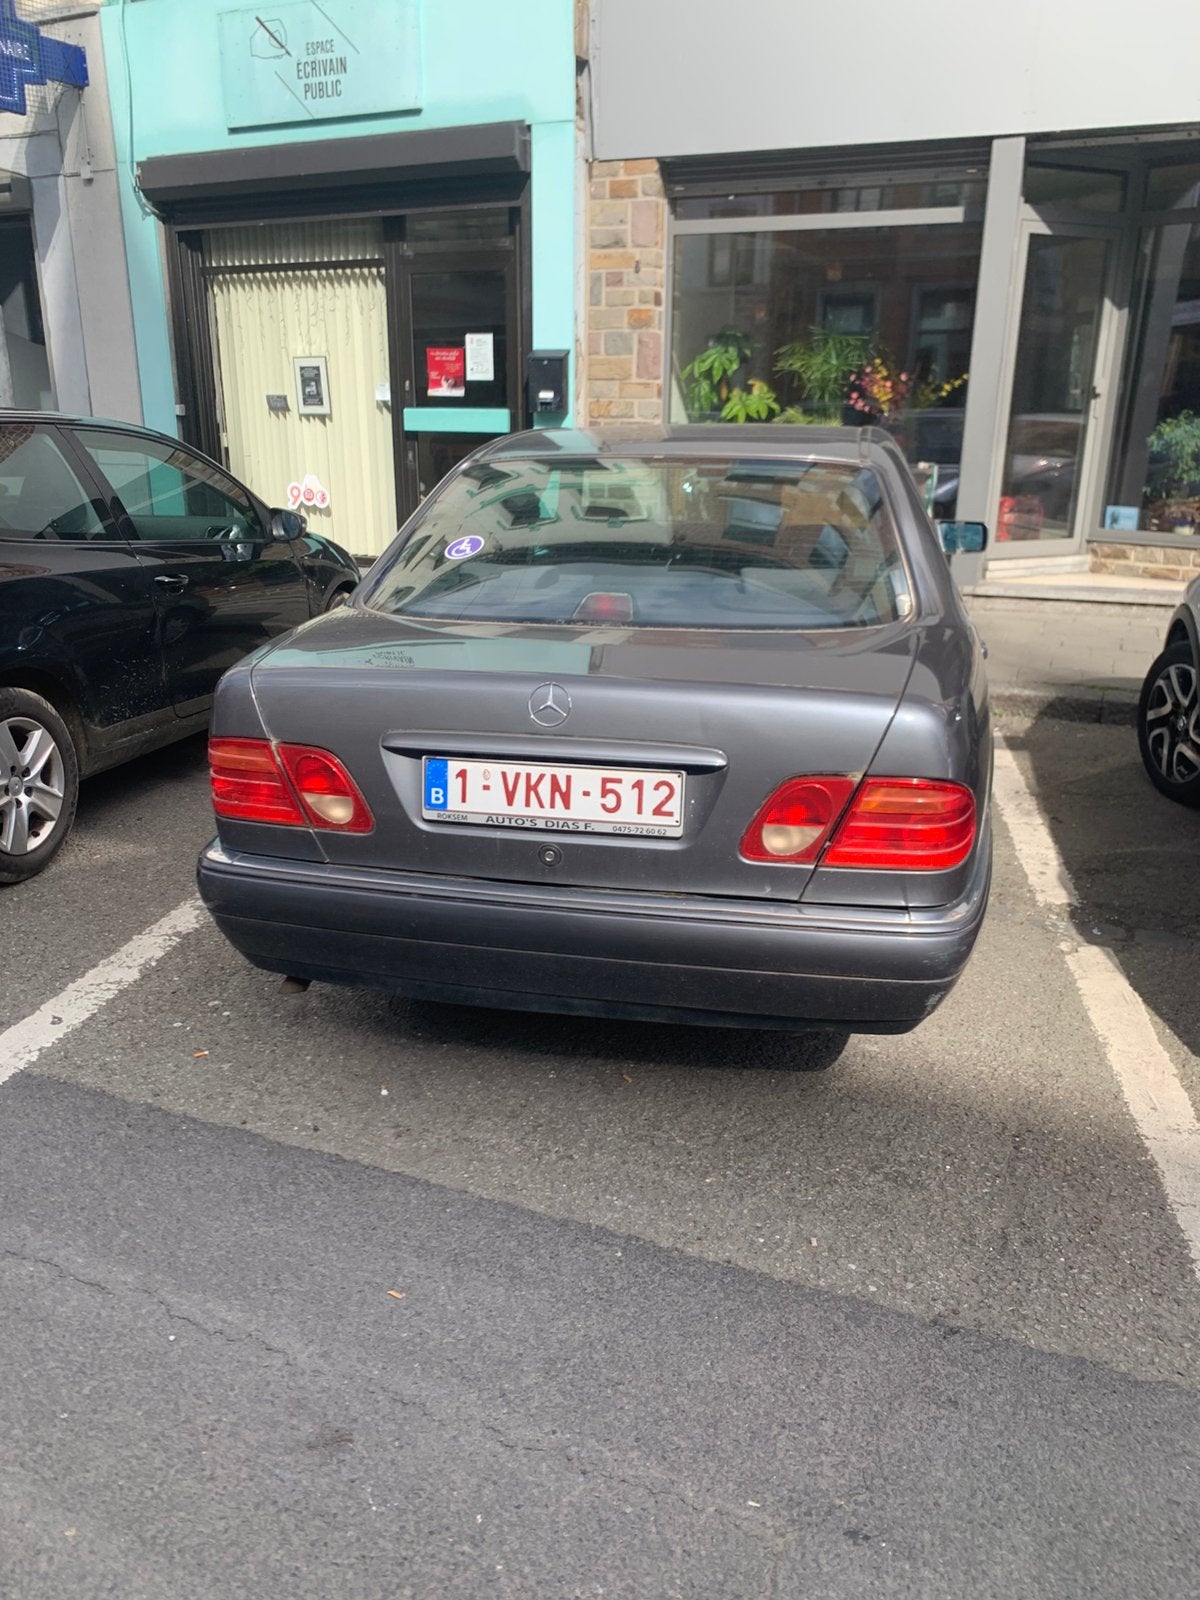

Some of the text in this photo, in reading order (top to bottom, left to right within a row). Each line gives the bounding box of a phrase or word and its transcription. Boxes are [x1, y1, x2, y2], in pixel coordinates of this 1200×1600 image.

[305, 39, 335, 56] ESPACE
[296, 56, 347, 80] ÉCRIVAIN
[304, 80, 342, 100] PUBLIC
[431, 787, 445, 805] B
[455, 768, 675, 818] 1-VKN-512
[436, 812, 468, 821] ROKSEM
[485, 815, 595, 831] AUTO'S DIAS F.
